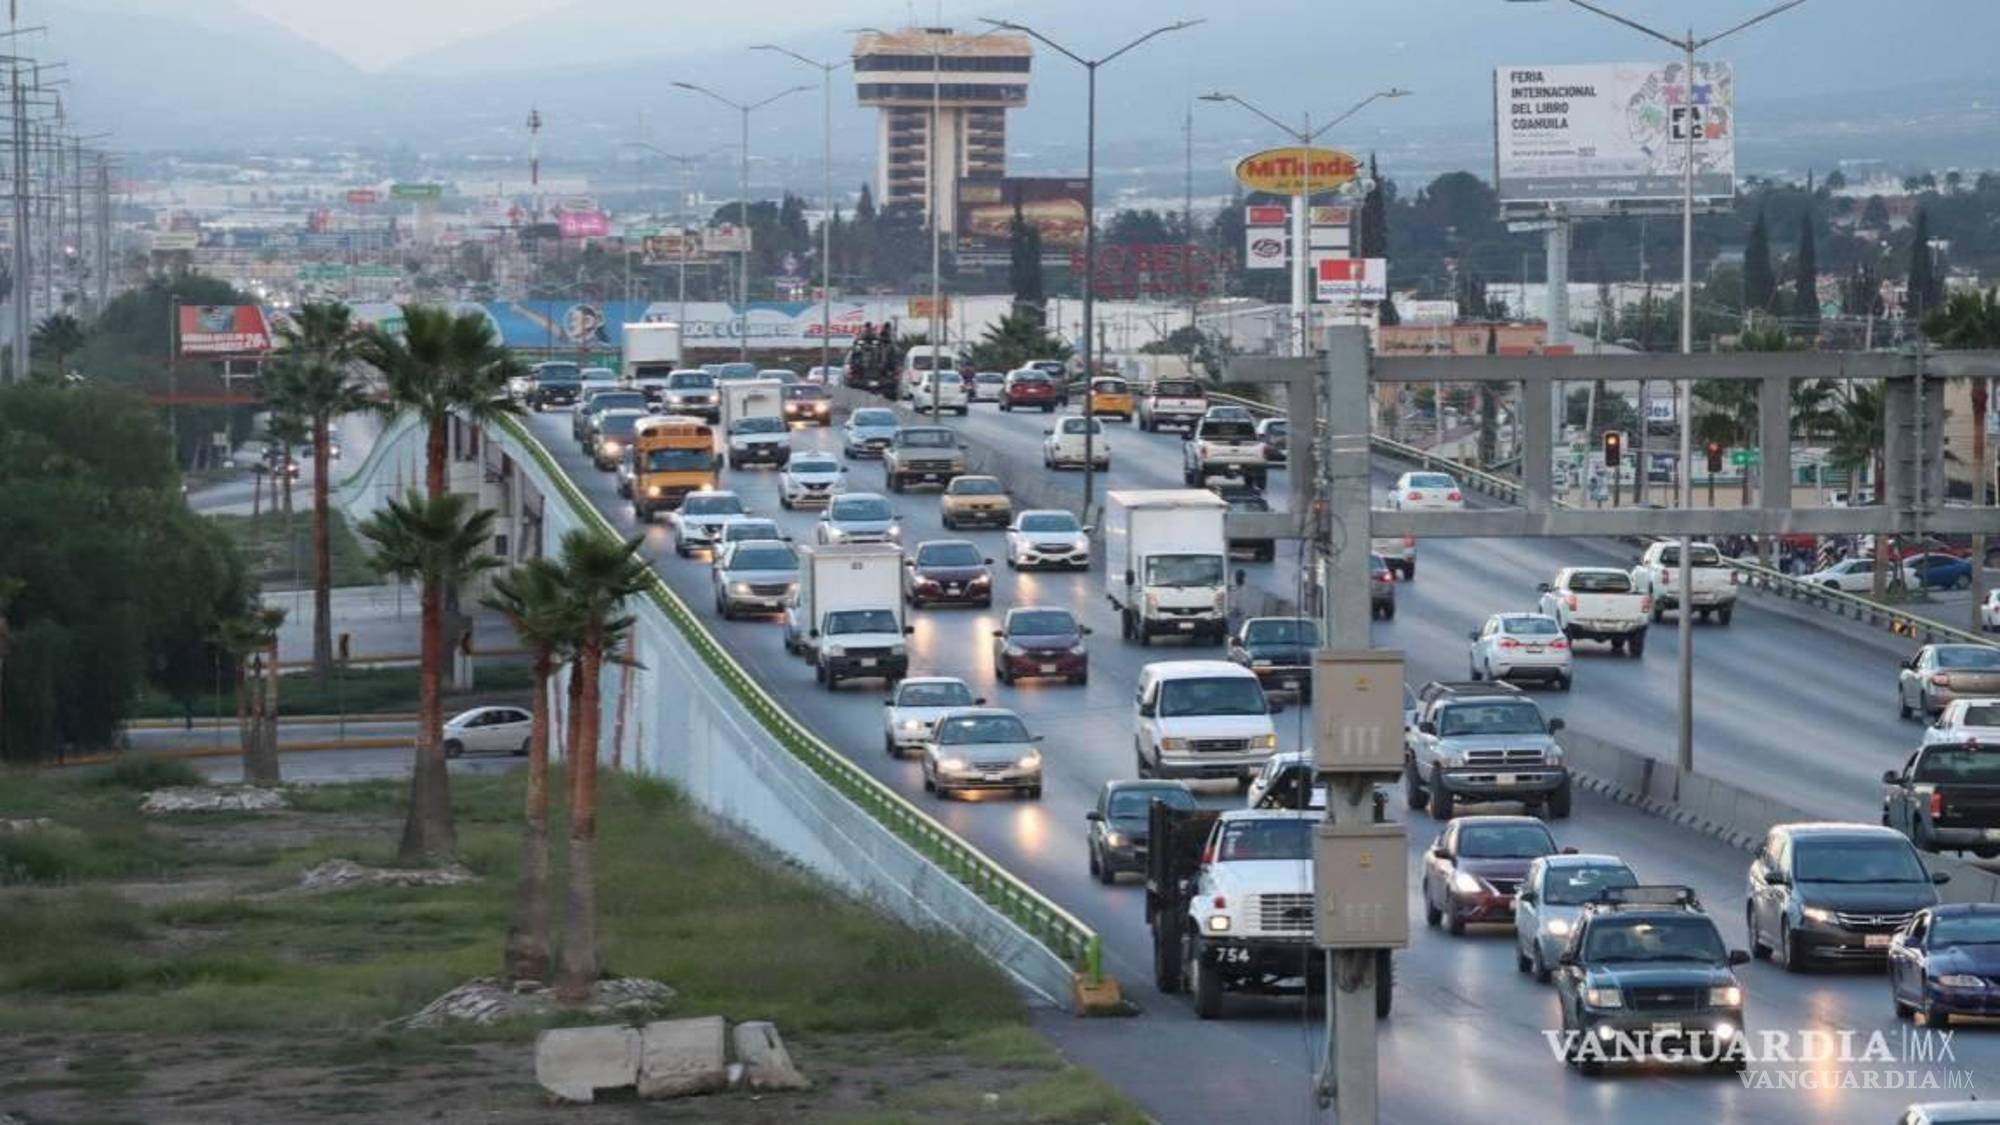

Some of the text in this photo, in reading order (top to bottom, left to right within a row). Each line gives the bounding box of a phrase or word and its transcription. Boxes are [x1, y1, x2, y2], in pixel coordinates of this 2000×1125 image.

[1511, 71, 1544, 82] FERIA
[1511, 86, 1597, 98] INTERNACIONAL
[1511, 102, 1569, 114] DEL LIBRO
[1511, 118, 1568, 130] COAHUILA
[1217, 948, 1250, 962] 754
